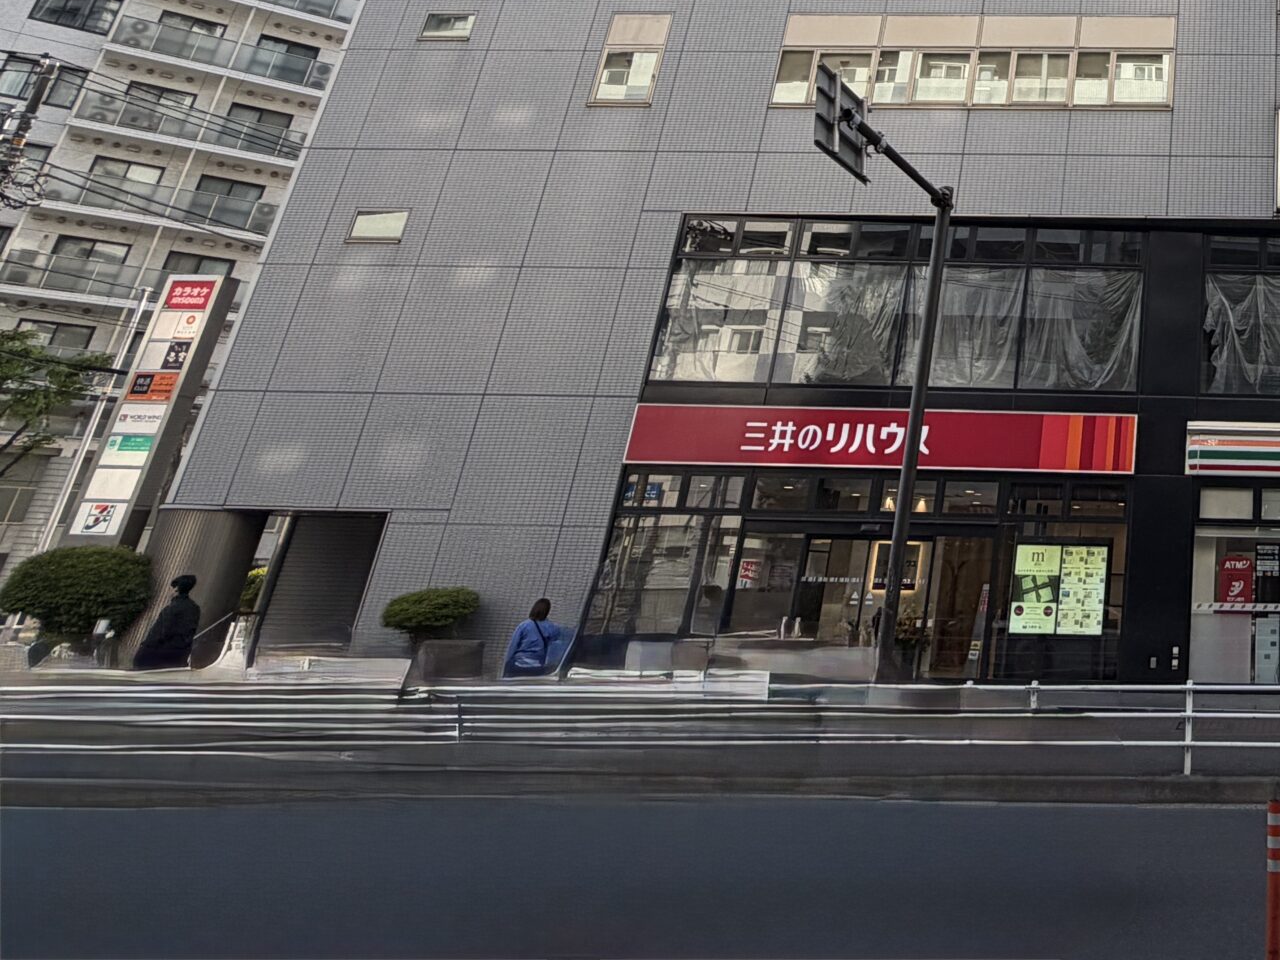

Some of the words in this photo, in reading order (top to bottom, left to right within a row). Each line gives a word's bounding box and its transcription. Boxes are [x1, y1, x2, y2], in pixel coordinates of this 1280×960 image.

[172, 287, 210, 296] カラオケ
[1224, 561, 1243, 569] ATM
